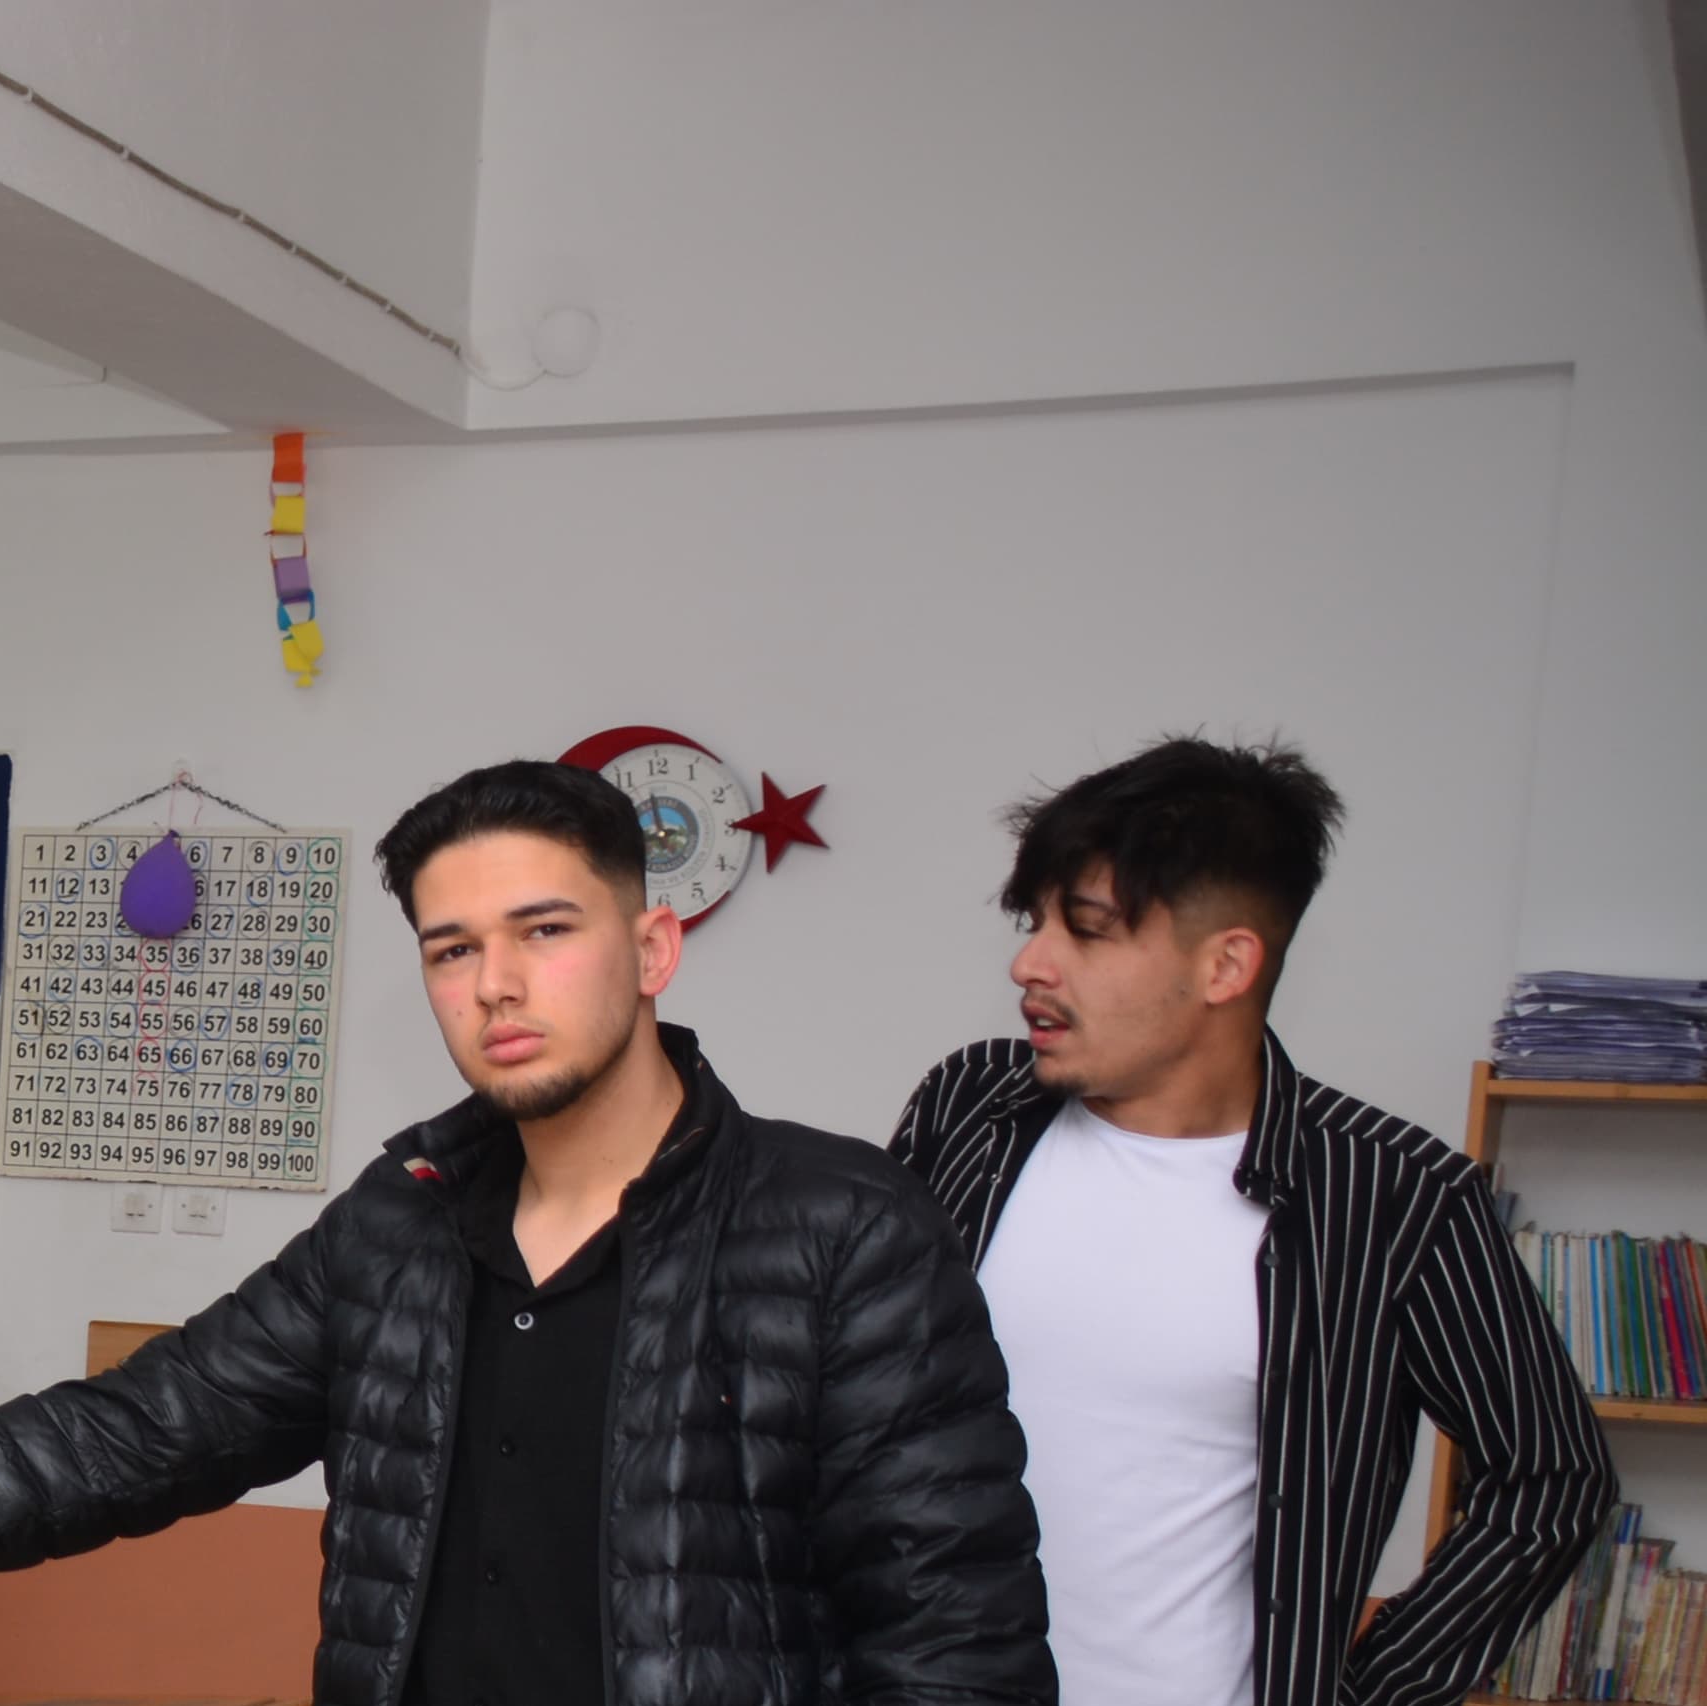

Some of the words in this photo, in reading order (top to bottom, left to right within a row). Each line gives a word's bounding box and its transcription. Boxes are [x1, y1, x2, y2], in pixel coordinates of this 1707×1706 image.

[647, 757, 669, 777] 12
[688, 763, 696, 781] 1
[712, 786, 726, 804] 2
[36, 844, 44, 861] 1
[64, 844, 76, 862] 2
[96, 844, 107, 862] 3
[126, 845, 138, 862] 4
[189, 845, 201, 864] 6
[222, 846, 233, 863] 7
[253, 846, 265, 864] 8
[286, 846, 297, 865] 9
[314, 847, 336, 865] 10
[715, 854, 726, 872] 4
[29, 877, 47, 894] 11
[57, 877, 80, 895] 12
[89, 878, 110, 895] 13
[214, 880, 237, 897] 17
[246, 880, 268, 898] 18
[279, 881, 301, 899] 19
[309, 881, 333, 899] 20
[691, 881, 705, 900] 5
[24, 910, 45, 927] 21
[54, 910, 77, 928] 22
[85, 911, 108, 929] 23
[210, 913, 234, 931] 27
[242, 914, 266, 932] 28
[274, 915, 298, 933] 29
[307, 915, 331, 933] 30
[23, 942, 43, 960] 31
[51, 943, 76, 962] 32
[83, 944, 106, 962] 33
[114, 945, 137, 962] 34
[145, 945, 168, 964] 35
[177, 946, 200, 964] 36
[208, 947, 232, 965] 37
[240, 948, 263, 966] 38
[272, 948, 296, 967] 39
[304, 950, 328, 968] 40
[20, 976, 41, 993] 41
[49, 977, 73, 994] 42
[80, 977, 103, 995] 43
[111, 979, 134, 996] 44
[142, 979, 166, 997] 45
[174, 980, 197, 998] 46
[205, 981, 229, 998] 47
[237, 982, 261, 1000] 48
[269, 983, 293, 1001] 49
[302, 984, 325, 1002] 50
[18, 1009, 39, 1026] 51
[47, 1010, 71, 1027] 52
[79, 1010, 101, 1028] 53
[109, 1011, 132, 1029] 54
[140, 1012, 164, 1030] 55
[172, 1013, 195, 1032] 56
[204, 1015, 227, 1032] 57
[235, 1016, 258, 1034] 58
[267, 1017, 291, 1035] 59
[299, 1018, 323, 1036] 60
[16, 1041, 36, 1059] 61
[45, 1042, 68, 1060] 62
[75, 1043, 98, 1061] 63
[107, 1045, 129, 1062] 64
[138, 1046, 161, 1064] 65
[169, 1047, 192, 1065] 66
[201, 1048, 224, 1066] 67
[233, 1049, 256, 1068] 68
[265, 1050, 288, 1069] 69
[297, 1052, 320, 1070] 70
[15, 1074, 35, 1092] 71
[44, 1076, 66, 1093] 72
[74, 1077, 96, 1095] 73
[106, 1078, 127, 1095] 74
[137, 1079, 159, 1097] 75
[168, 1080, 191, 1099] 76
[199, 1082, 222, 1099] 77
[230, 1083, 253, 1102] 78
[263, 1084, 286, 1103] 79
[294, 1086, 318, 1104] 80
[12, 1107, 32, 1125] 81
[41, 1108, 64, 1126] 82
[72, 1110, 94, 1128] 83
[102, 1111, 125, 1129] 84
[133, 1112, 157, 1131] 85
[165, 1114, 188, 1132] 86
[196, 1115, 220, 1133] 87
[228, 1117, 251, 1135] 88
[260, 1118, 283, 1137] 89
[292, 1120, 316, 1138] 90
[10, 1140, 30, 1157] 91
[39, 1141, 62, 1159] 92
[70, 1143, 92, 1161] 93
[100, 1144, 123, 1162] 94
[131, 1146, 155, 1164] 95
[163, 1147, 186, 1166] 96
[194, 1149, 217, 1167] 97
[226, 1151, 249, 1169] 98
[258, 1152, 281, 1171] 99
[287, 1154, 314, 1173] 100
